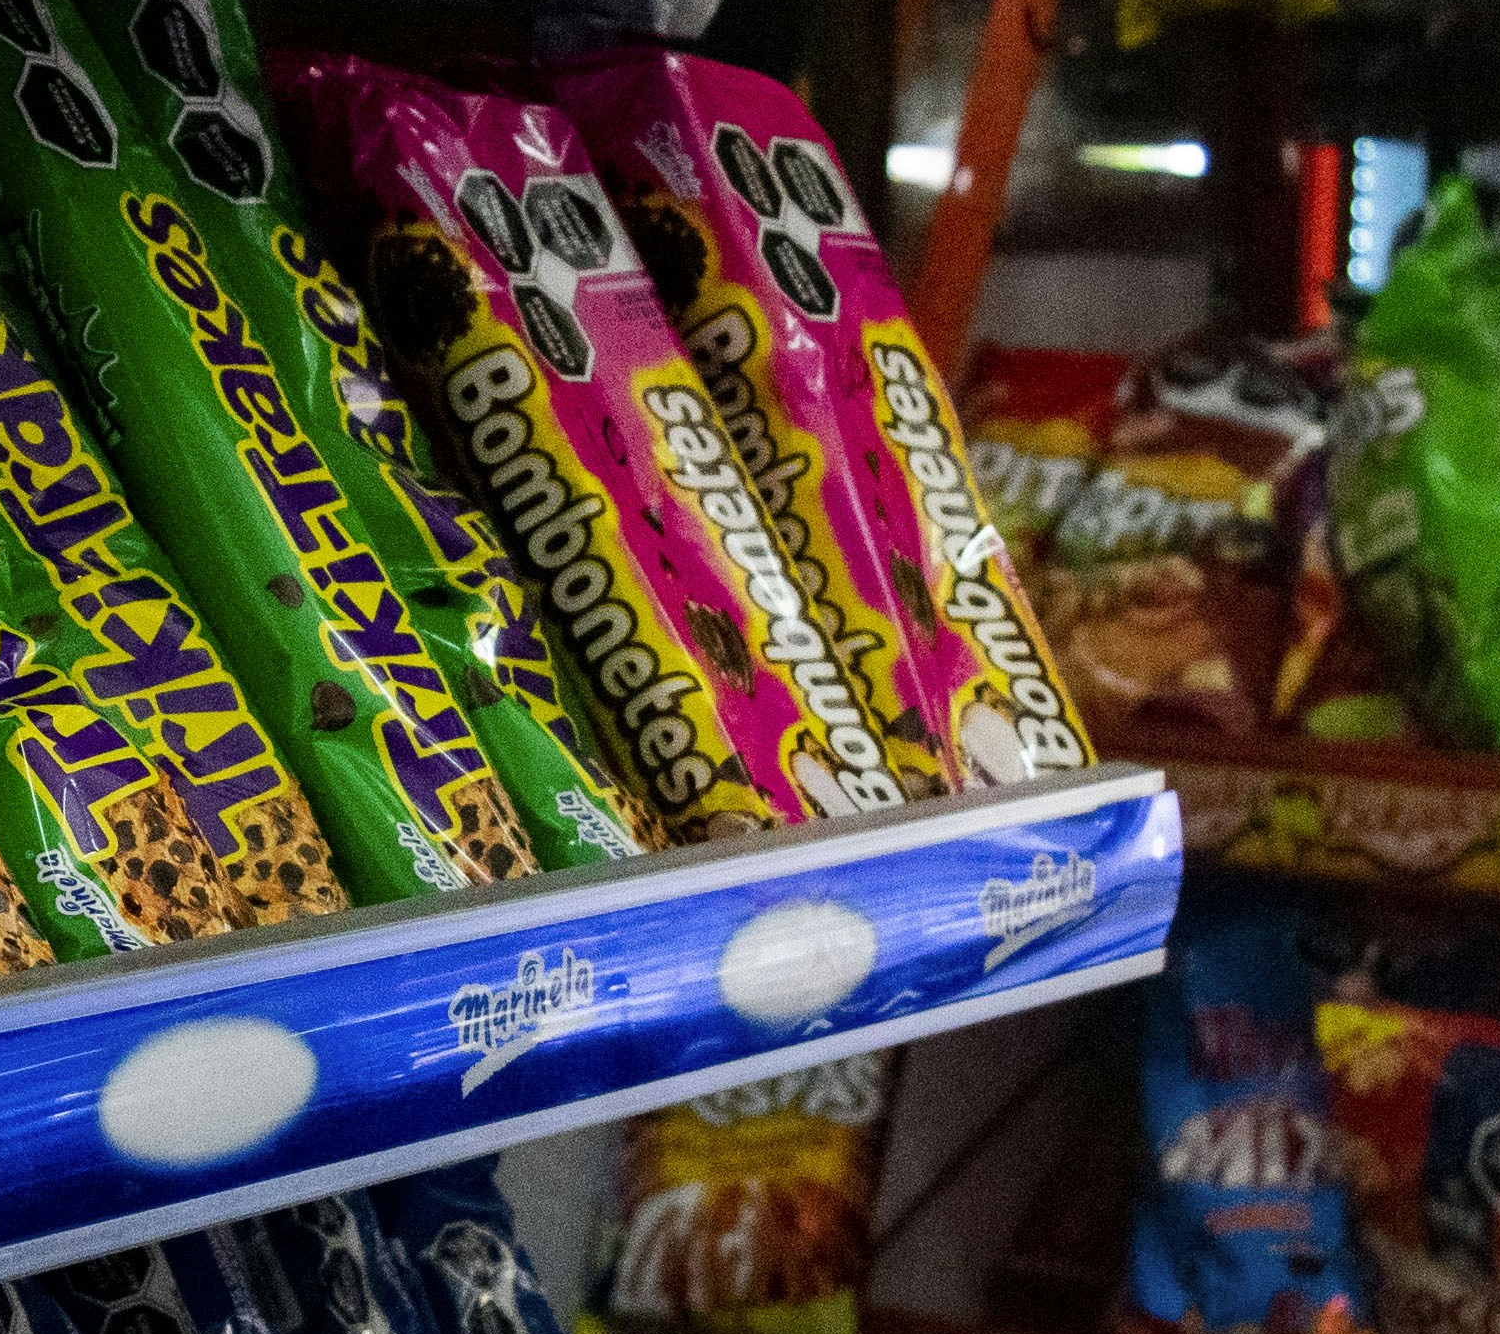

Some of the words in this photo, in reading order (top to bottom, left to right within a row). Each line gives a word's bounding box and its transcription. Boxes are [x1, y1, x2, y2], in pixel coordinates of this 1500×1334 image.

[118, 190, 495, 844] Triki-Trakes
[445, 344, 714, 810] Bombonetes
[642, 384, 907, 817] Bombonetes
[872, 344, 1087, 775] Bombnetes
[448, 951, 596, 1052] Marinela
